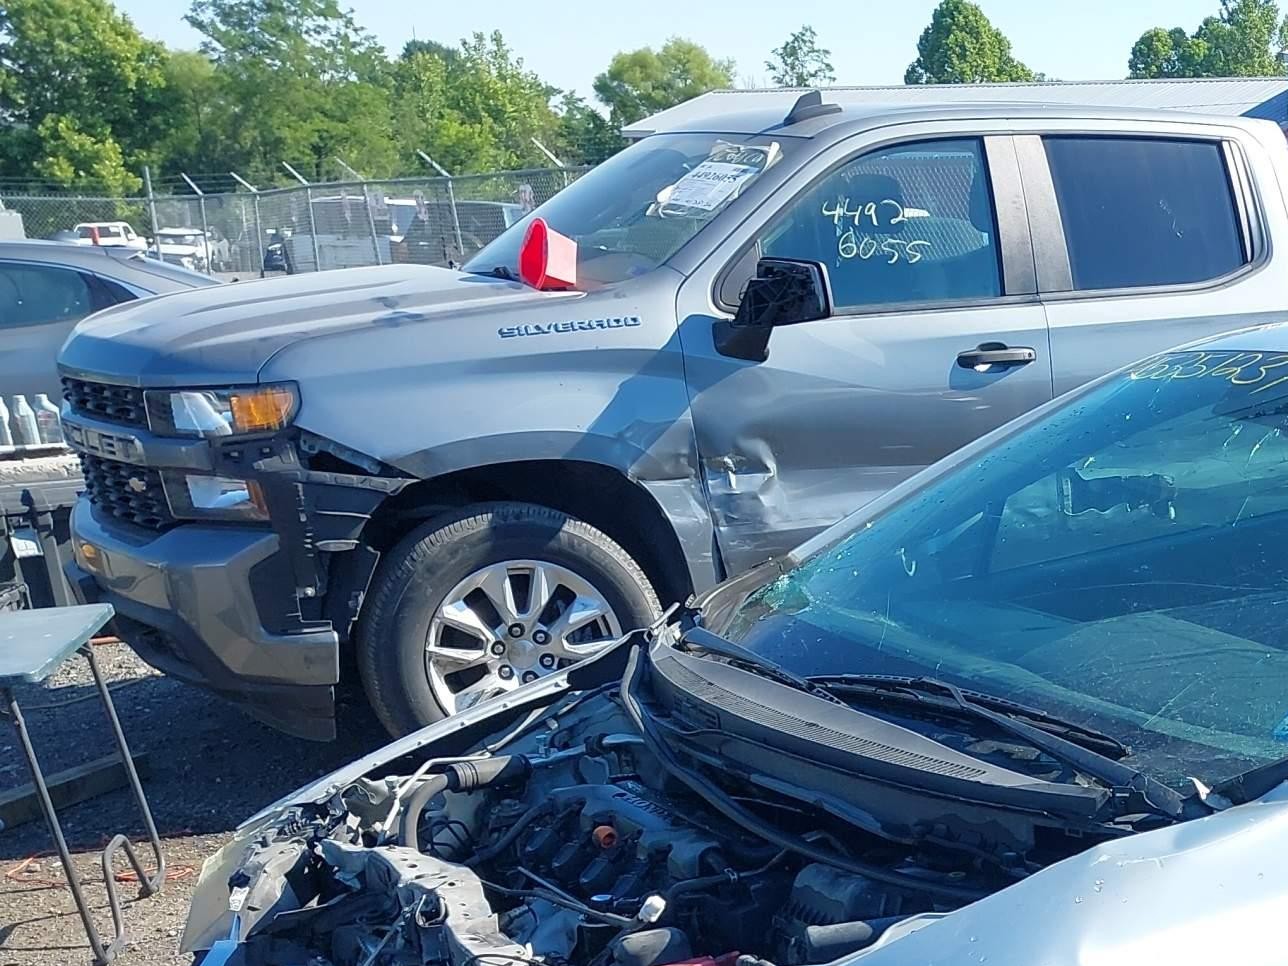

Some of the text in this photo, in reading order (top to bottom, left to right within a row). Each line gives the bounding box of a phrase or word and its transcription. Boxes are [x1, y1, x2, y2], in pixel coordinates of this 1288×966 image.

[822, 198, 908, 226] 4492
[839, 227, 931, 264] 6055
[498, 315, 642, 339] SILVERADO
